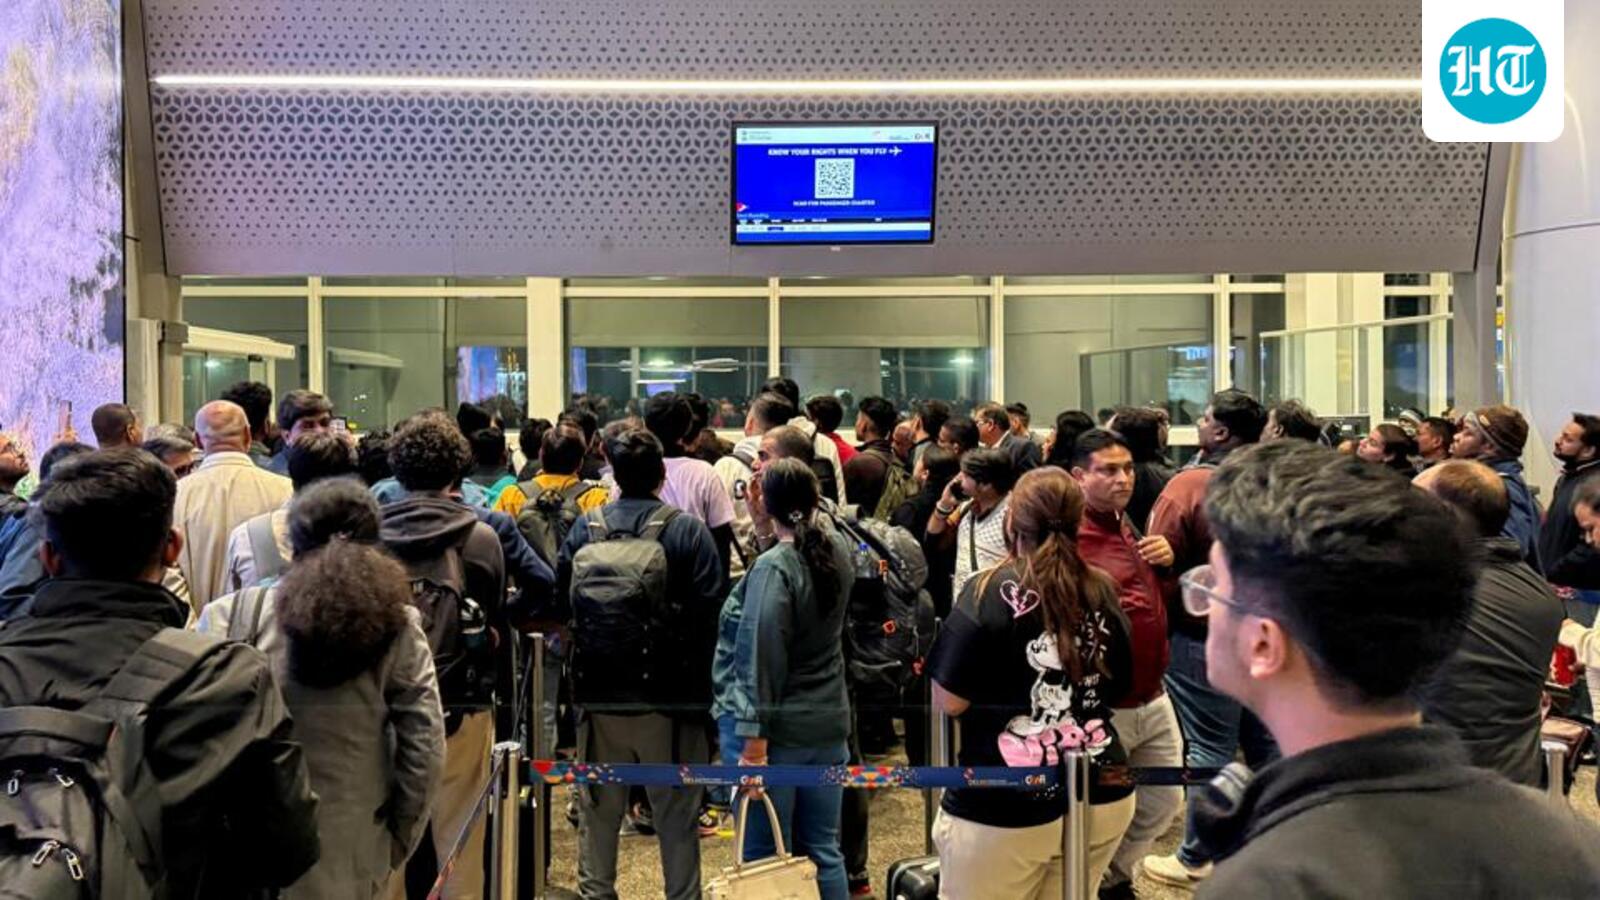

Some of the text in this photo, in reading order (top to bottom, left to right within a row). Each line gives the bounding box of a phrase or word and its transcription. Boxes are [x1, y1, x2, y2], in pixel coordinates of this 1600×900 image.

[768, 148, 789, 156] KNOW
[791, 148, 809, 156] YOUR
[811, 148, 836, 156] RIGHTS
